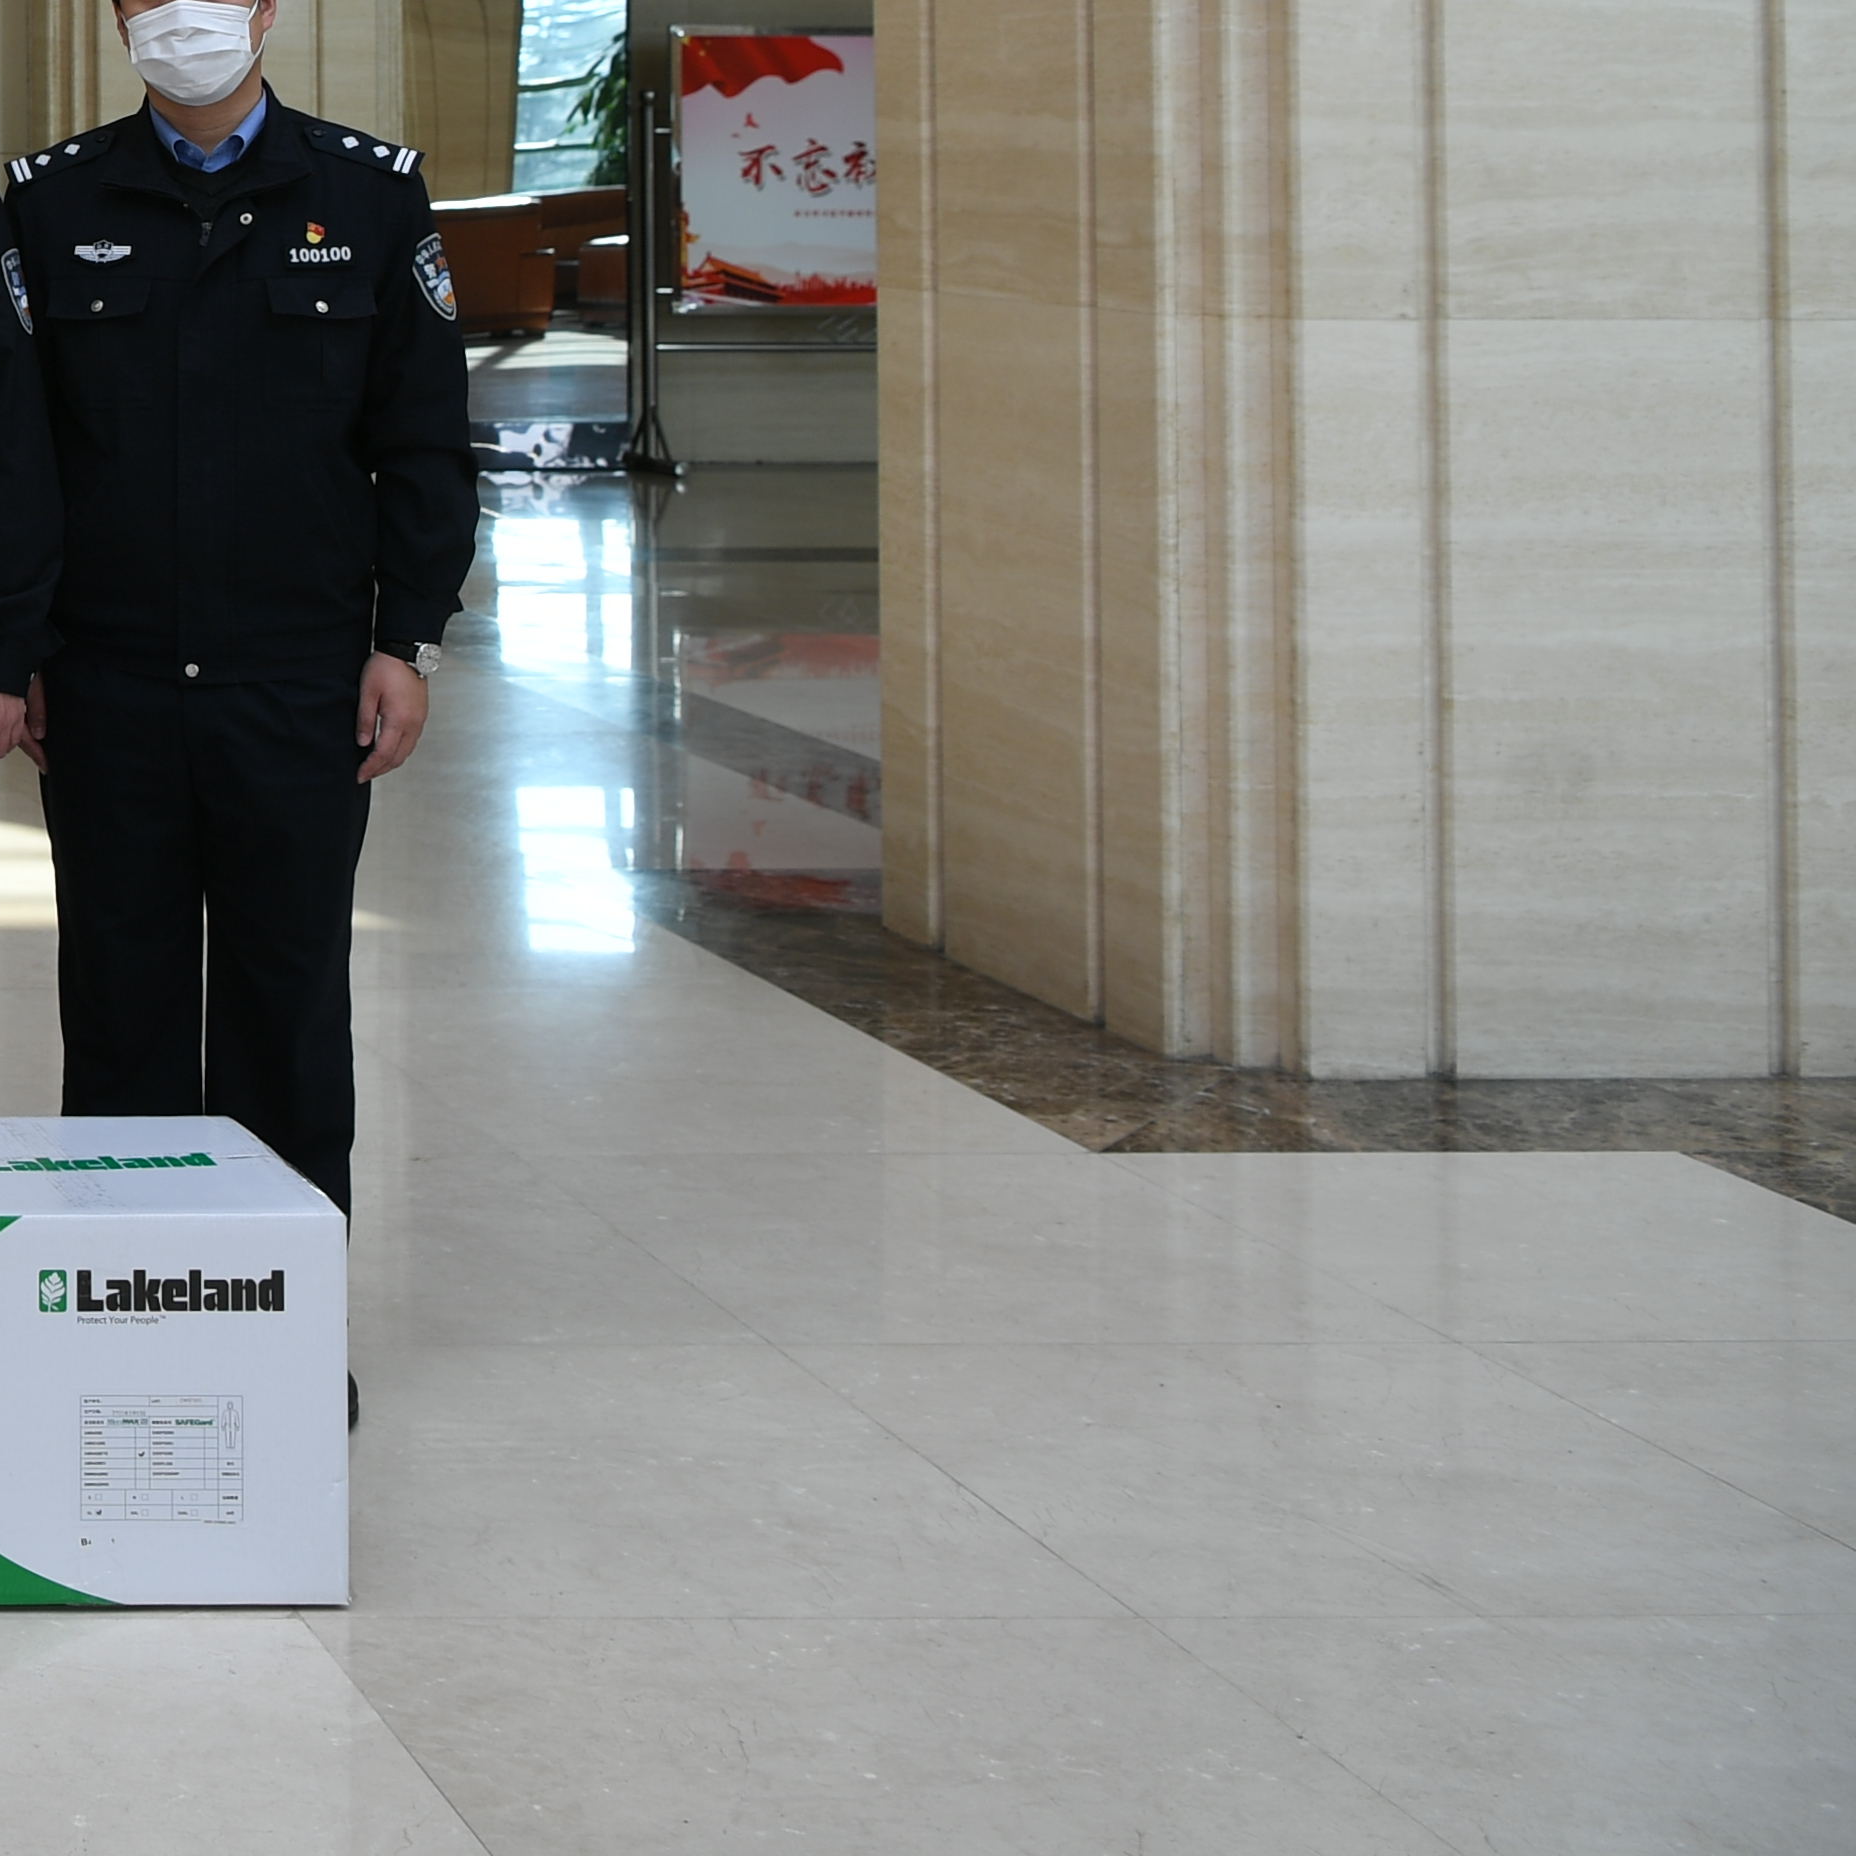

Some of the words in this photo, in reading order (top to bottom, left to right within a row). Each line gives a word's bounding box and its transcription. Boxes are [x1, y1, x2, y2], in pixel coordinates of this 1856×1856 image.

[289, 245, 352, 263] 100100
[77, 1270, 285, 1312] Lakeland
[77, 1315, 106, 1324] Protect
[109, 1315, 128, 1324] Your
